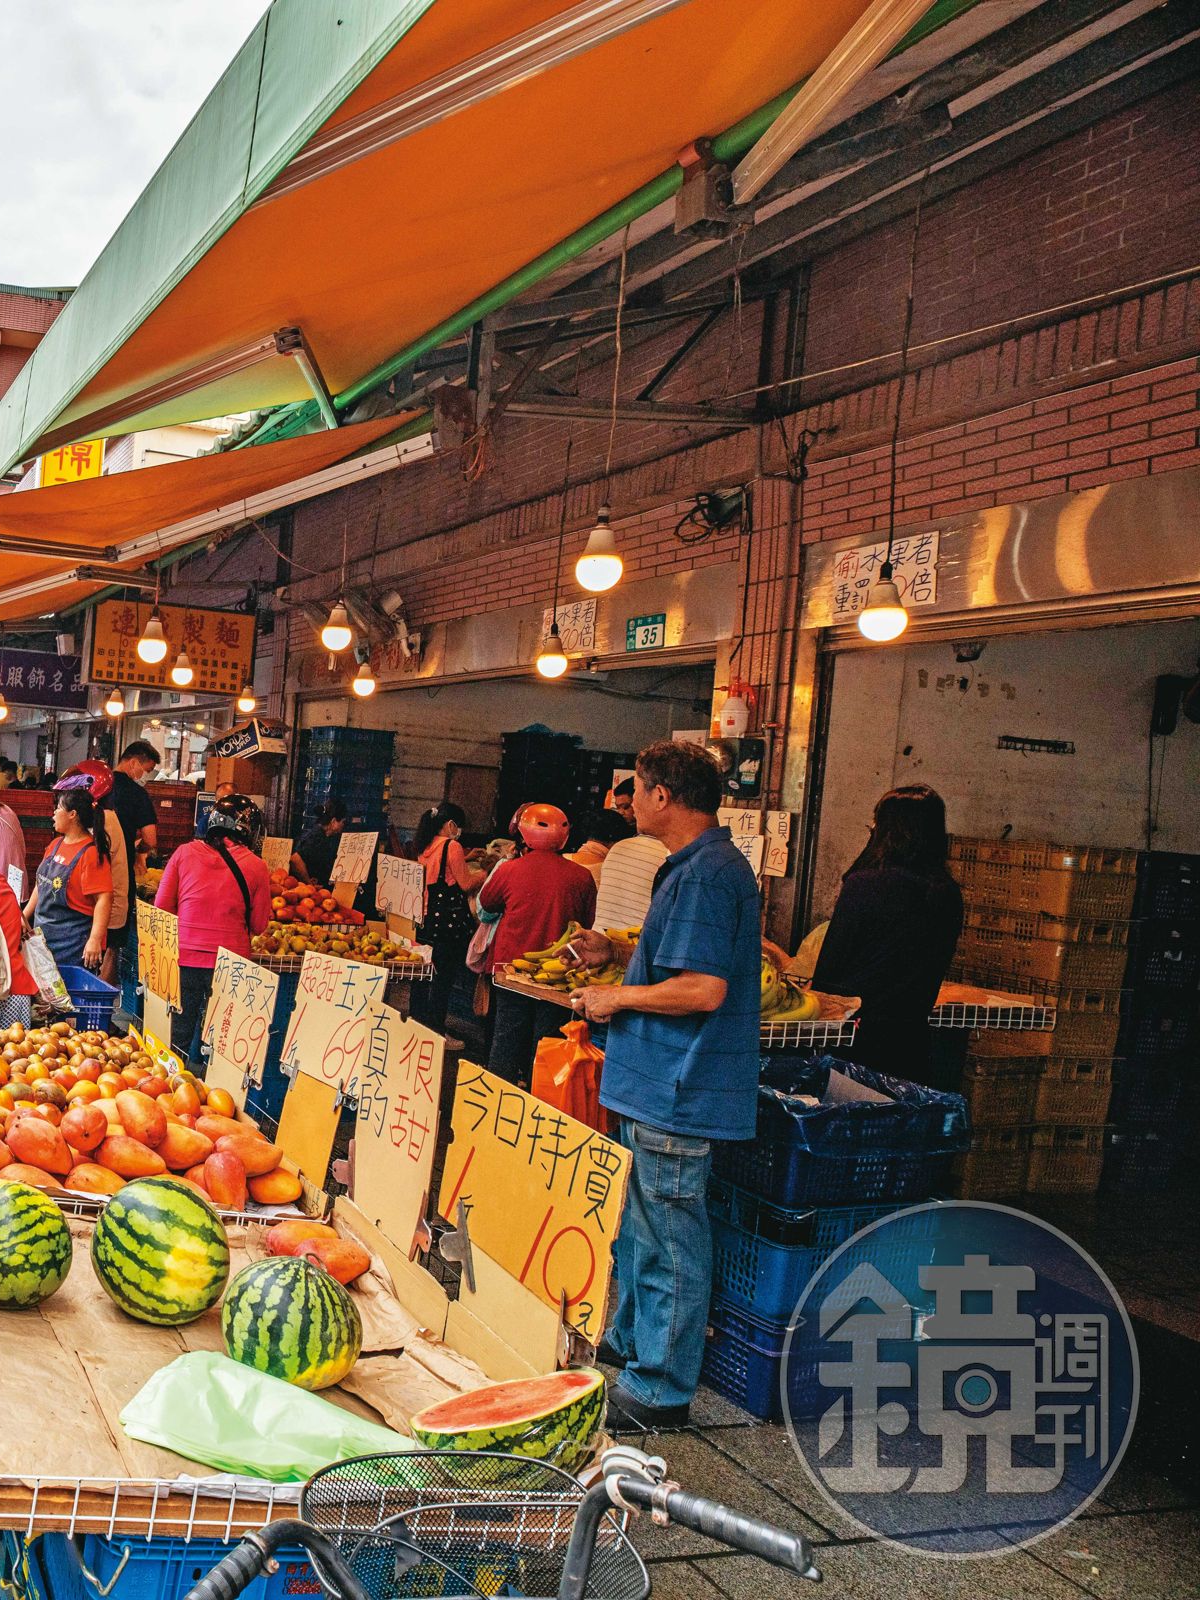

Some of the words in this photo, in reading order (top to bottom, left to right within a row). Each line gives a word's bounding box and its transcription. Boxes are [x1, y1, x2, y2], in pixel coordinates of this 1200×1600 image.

[833, 534, 932, 579] 偷水果者
[641, 626, 658, 646] 35
[379, 855, 423, 891] 今日特價
[359, 1008, 390, 1139] 真的
[389, 1032, 435, 1163] 很甜
[456, 1071, 623, 1234] 今日特價
